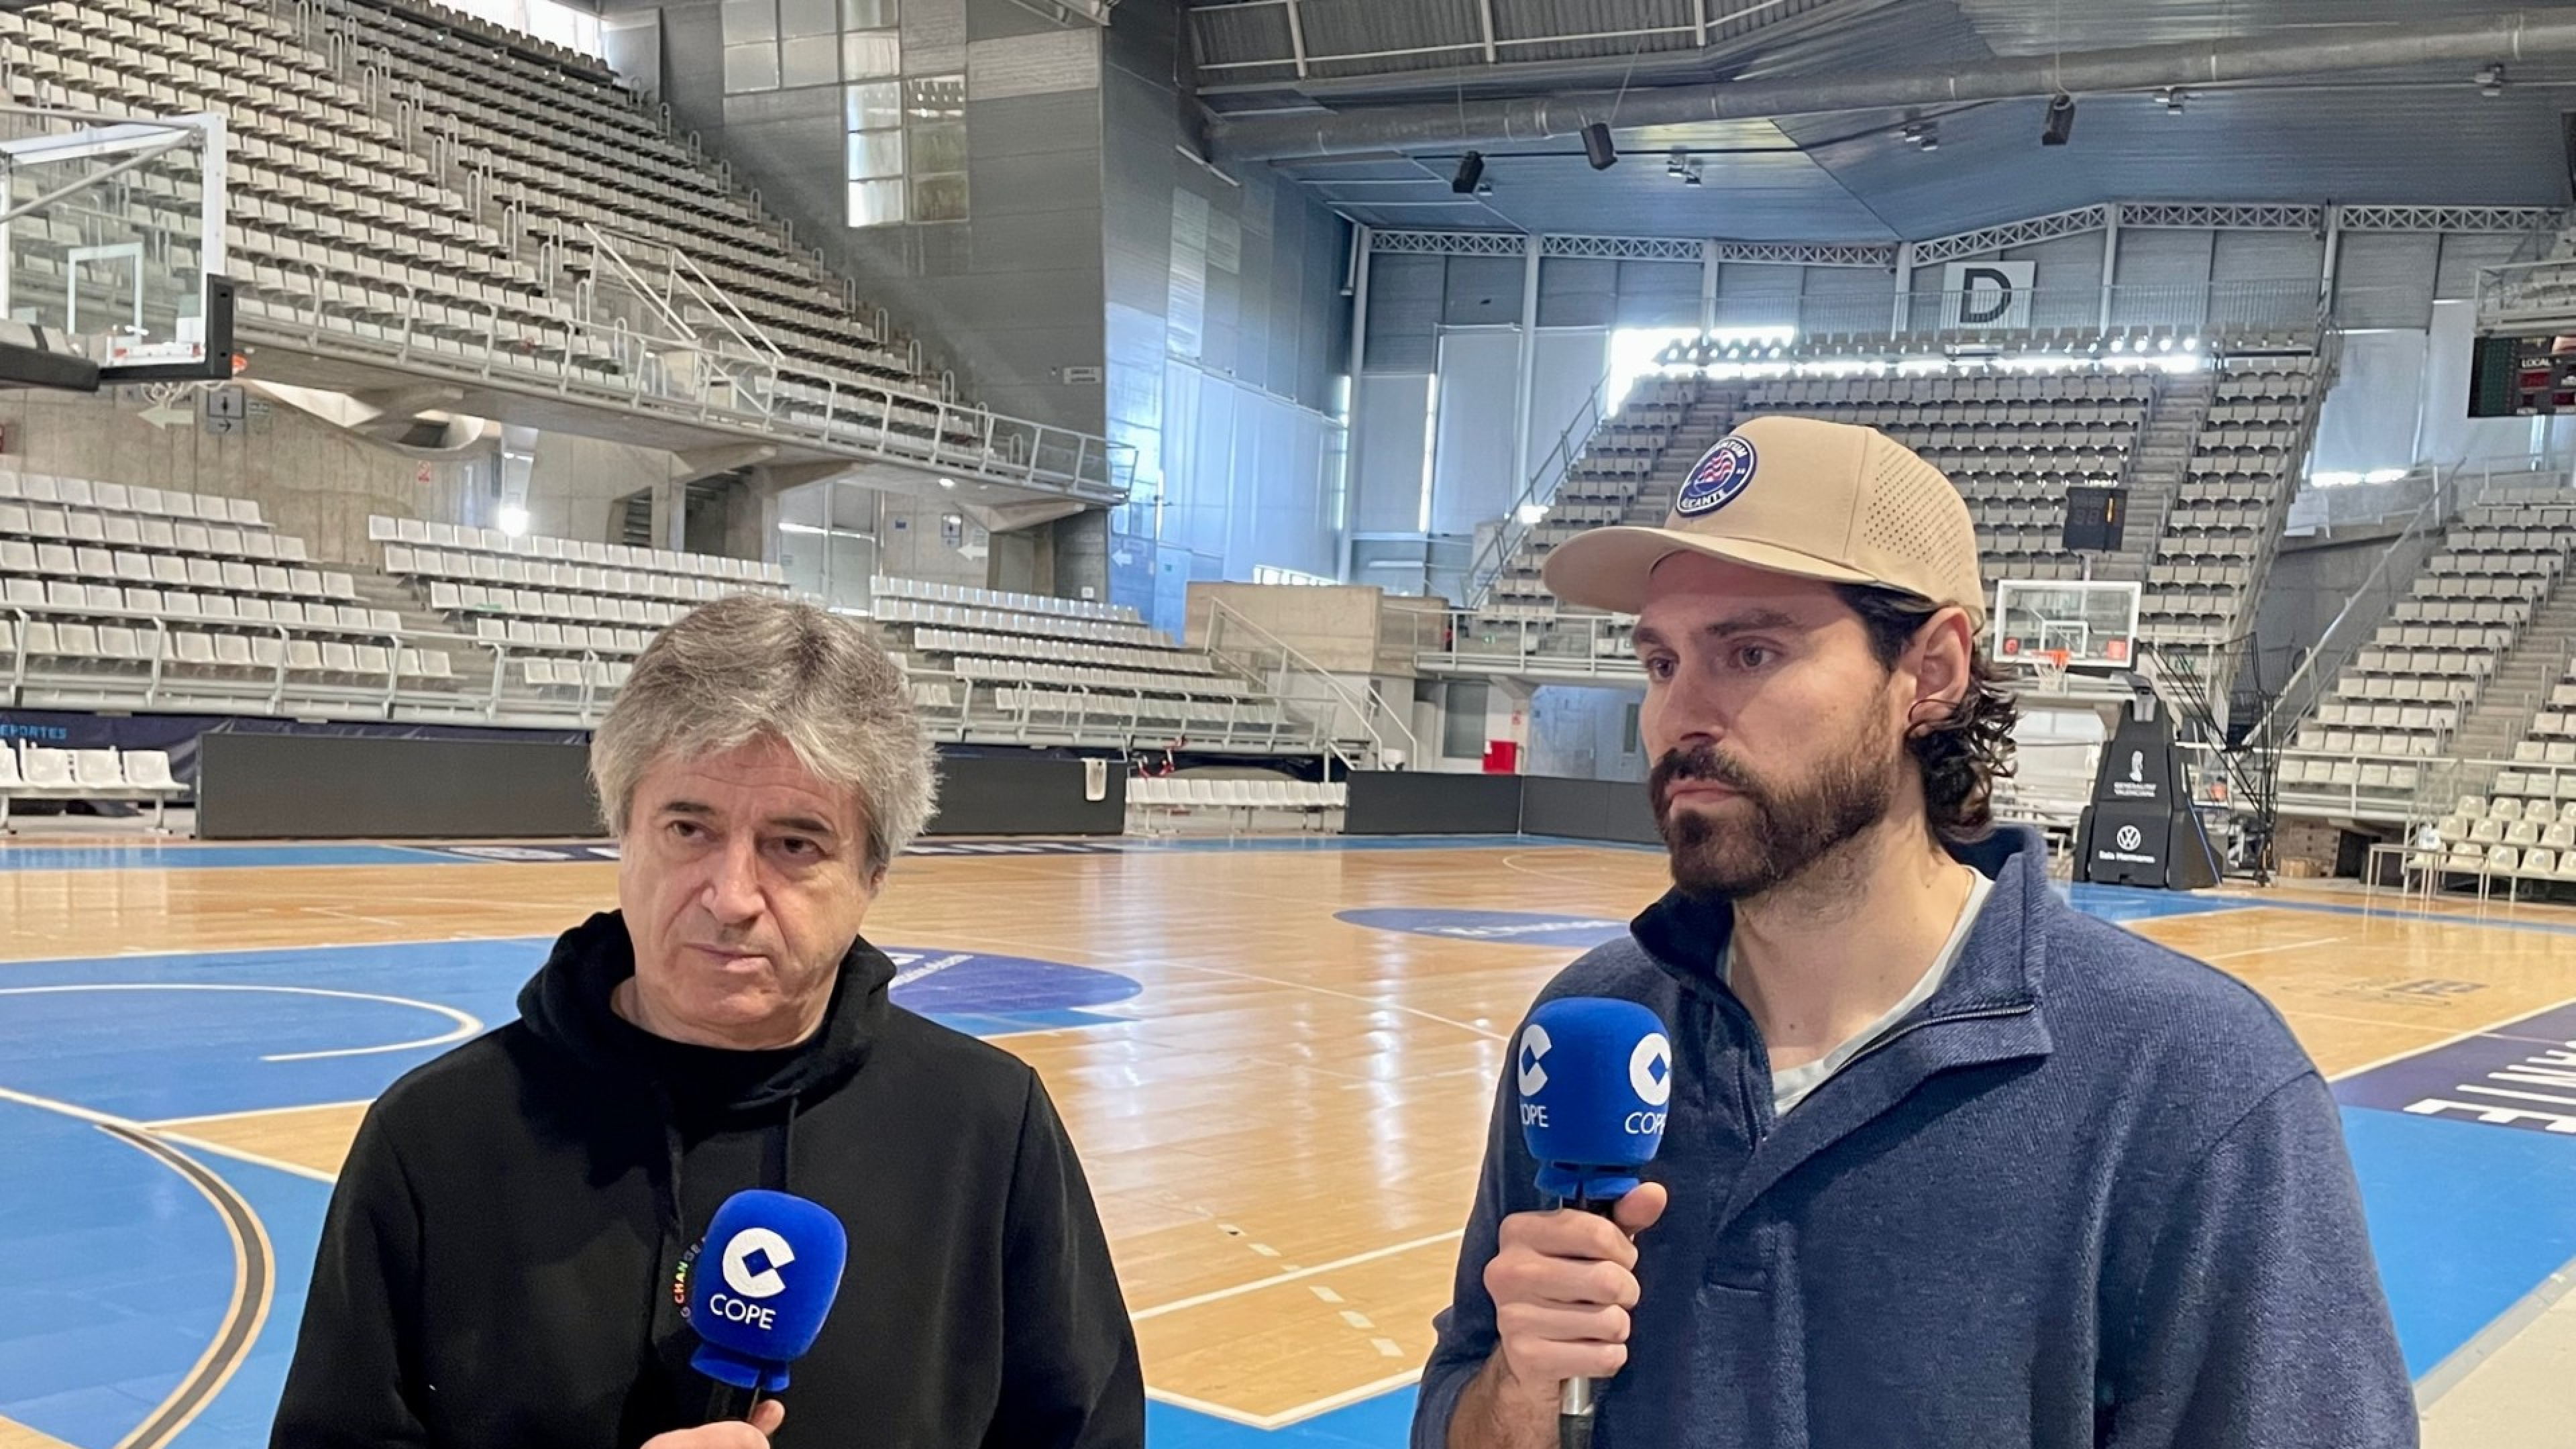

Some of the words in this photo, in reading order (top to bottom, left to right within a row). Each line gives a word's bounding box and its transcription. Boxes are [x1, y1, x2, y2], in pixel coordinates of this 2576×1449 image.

[1960, 268, 2012, 324] D
[0, 724, 67, 740] EPORTES
[1521, 1104, 1549, 1128] OPE
[710, 1293, 777, 1330] COPE
